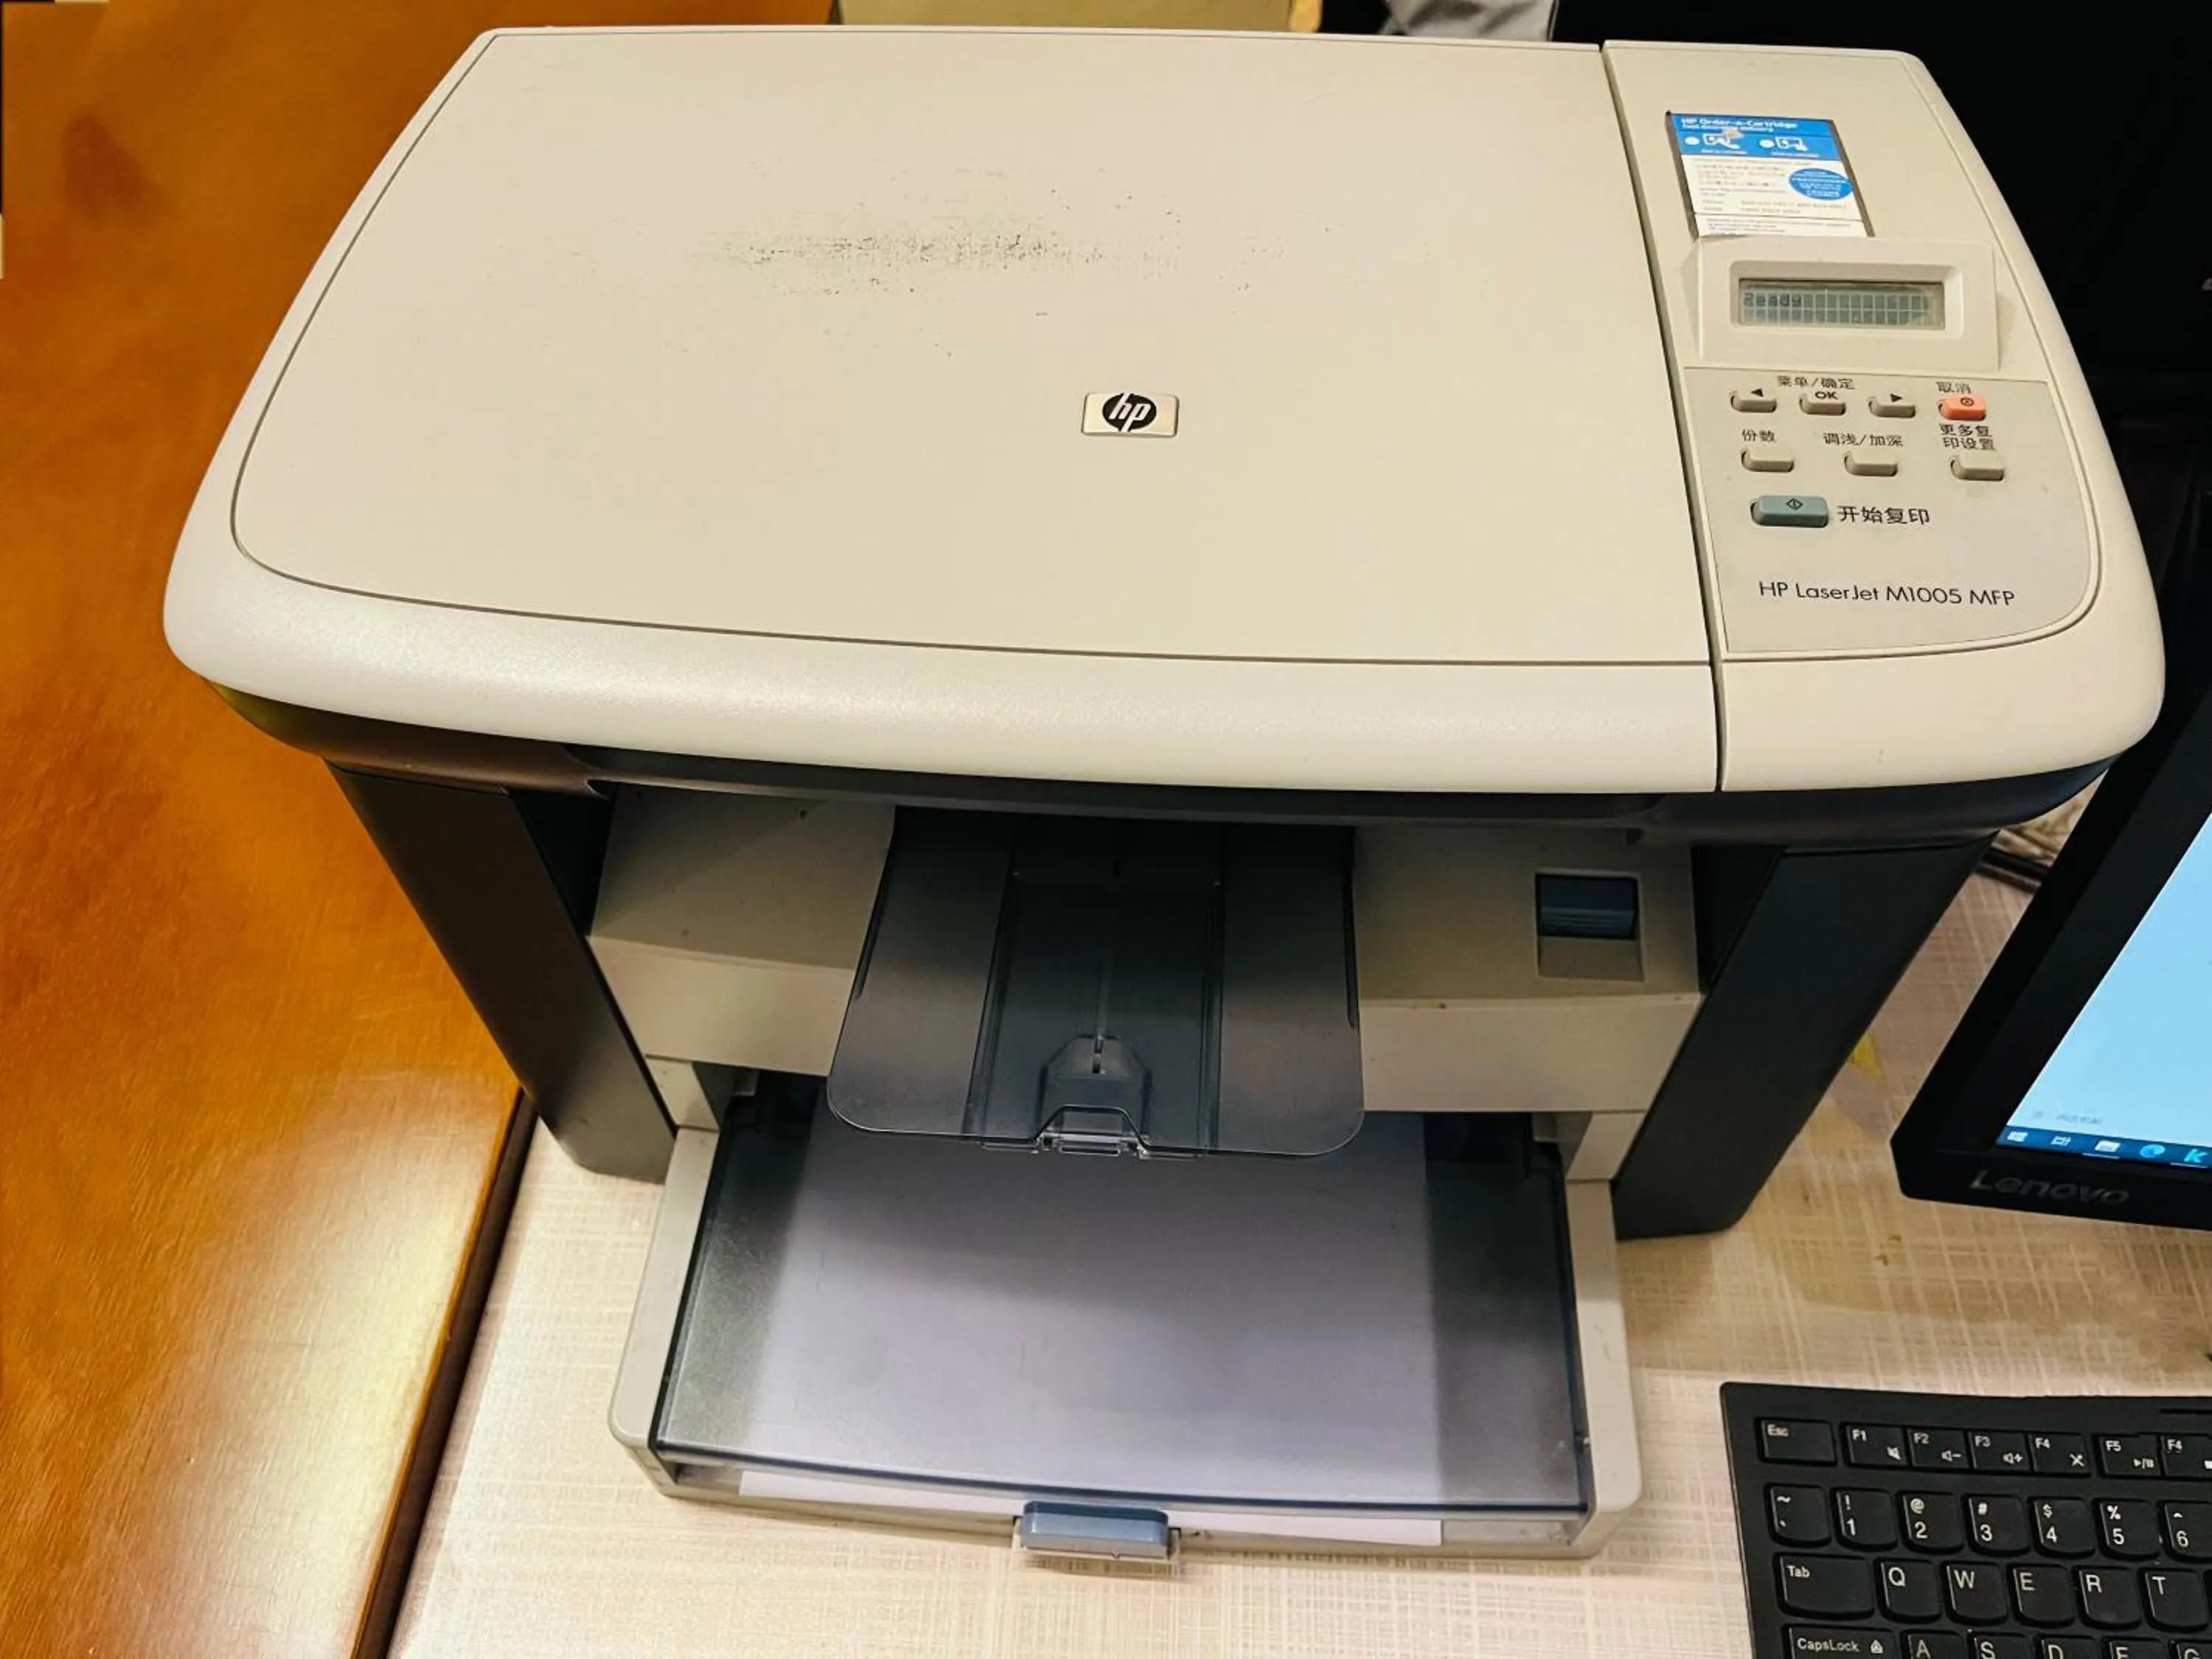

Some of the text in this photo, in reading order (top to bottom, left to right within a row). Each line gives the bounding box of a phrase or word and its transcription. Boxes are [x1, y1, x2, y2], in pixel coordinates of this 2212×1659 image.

[1743, 293, 1801, 307] Ready
[1778, 375, 1855, 391] 菜单/确定
[1936, 381, 1972, 394] 取消
[1815, 390, 1839, 400] OK
[1107, 392, 1153, 432] hp
[1741, 428, 1775, 442] 份数
[1939, 424, 1992, 437] 更多复
[1823, 432, 1904, 448] 调浅/加深
[1943, 437, 1994, 450] 印设置
[1840, 505, 1930, 525] 开始复印
[1759, 581, 2015, 606] HP LaserJet M1005 MFP
[1969, 1169, 2129, 1206] Lenovo
[1767, 1425, 1789, 1437] Esc
[1852, 1429, 1868, 1441] F1
[1913, 1433, 1929, 1444] F2
[1975, 1436, 1990, 1447] F3
[2035, 1438, 2051, 1449] F4
[2106, 1440, 2121, 1452] F5
[1846, 1517, 1856, 1536] 1
[1914, 1521, 1928, 1539] 2
[1980, 1524, 1993, 1541] 3
[2046, 1526, 2057, 1543] 4
[2112, 1528, 2125, 1545] 5
[2176, 1530, 2188, 1548] 6
[1787, 1565, 1810, 1579] Tab
[1888, 1567, 1906, 1587] Q
[1954, 1569, 1975, 1589] W
[2020, 1572, 2035, 1591] E
[2085, 1573, 2103, 1593] R
[2152, 1576, 2166, 1595] T
[1797, 1638, 1859, 1652] CapsLock
[1916, 1639, 1933, 1659] A
[1980, 1641, 1996, 1659] S
